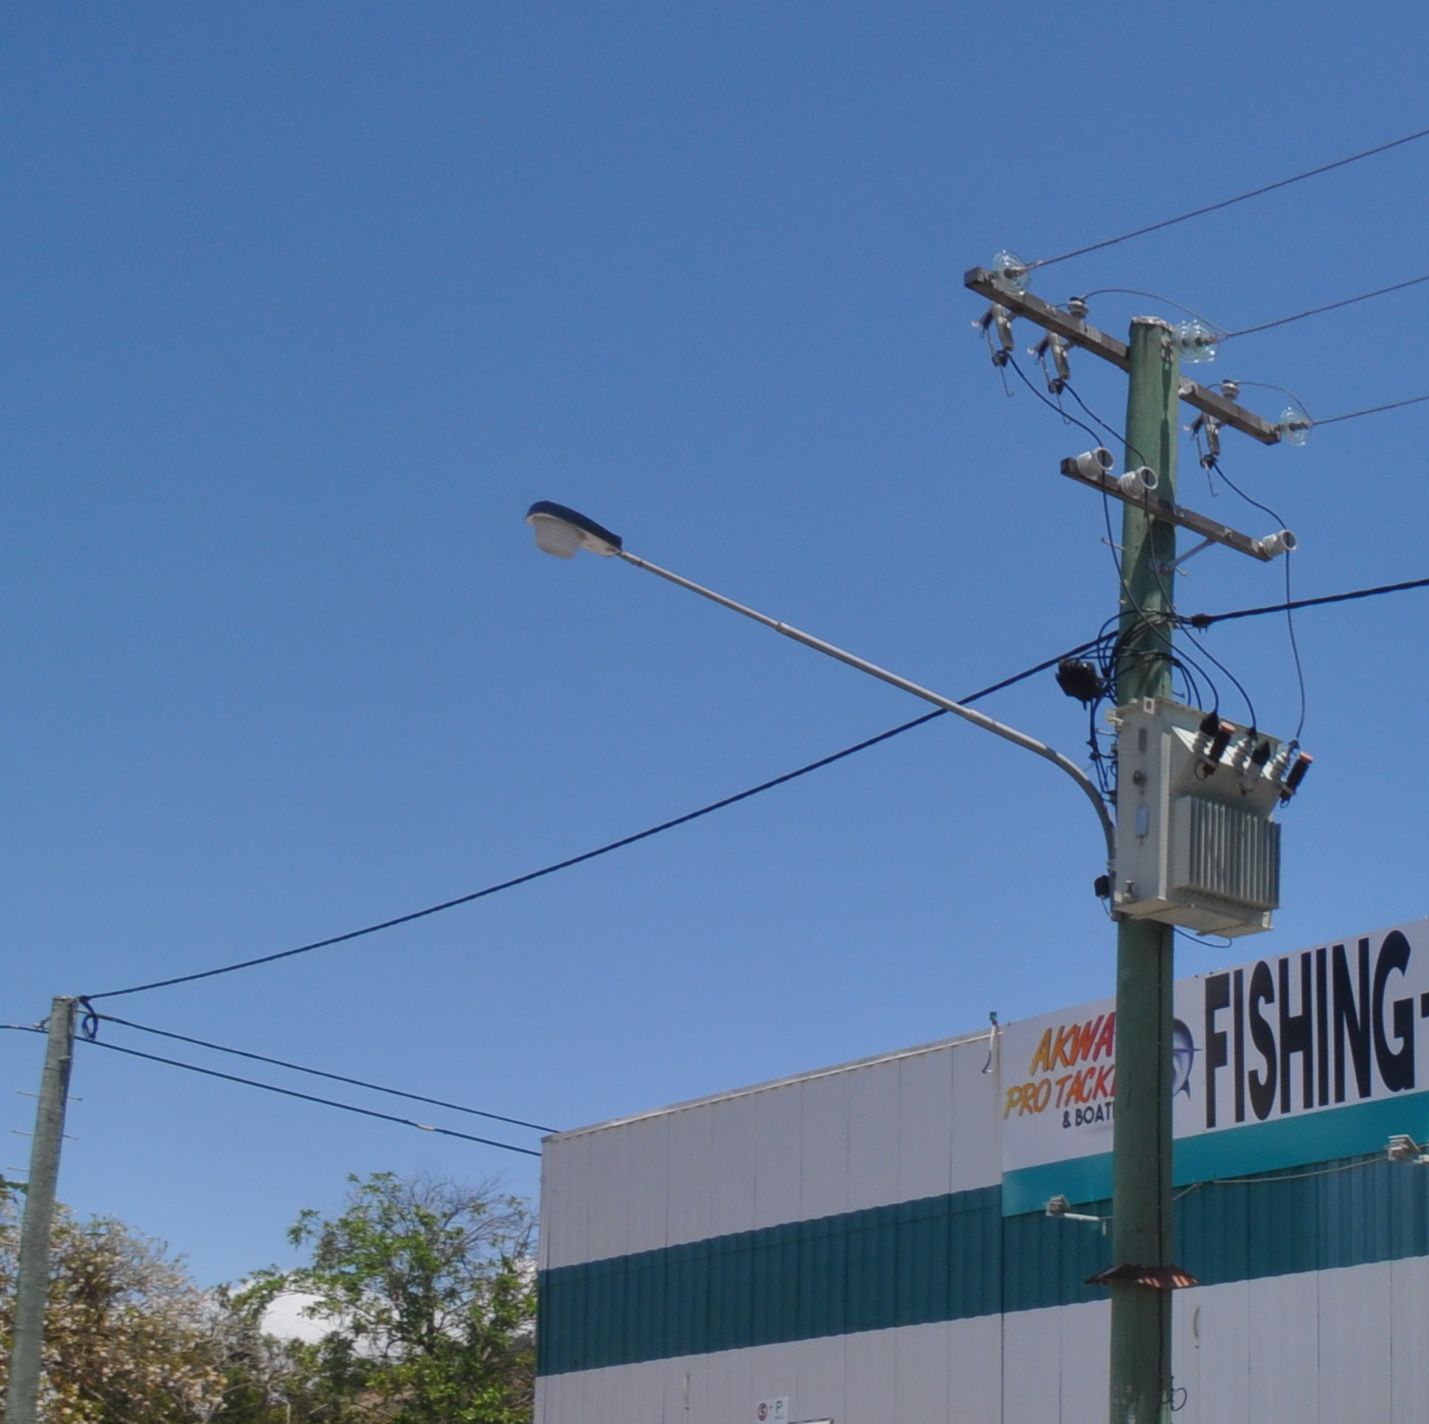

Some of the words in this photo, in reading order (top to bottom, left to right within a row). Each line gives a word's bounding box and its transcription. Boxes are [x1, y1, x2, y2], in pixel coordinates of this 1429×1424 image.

[1029, 1011, 1117, 1076] AKWA
[1003, 1078, 1052, 1120] PRO
[1062, 1110, 1072, 1129] &
